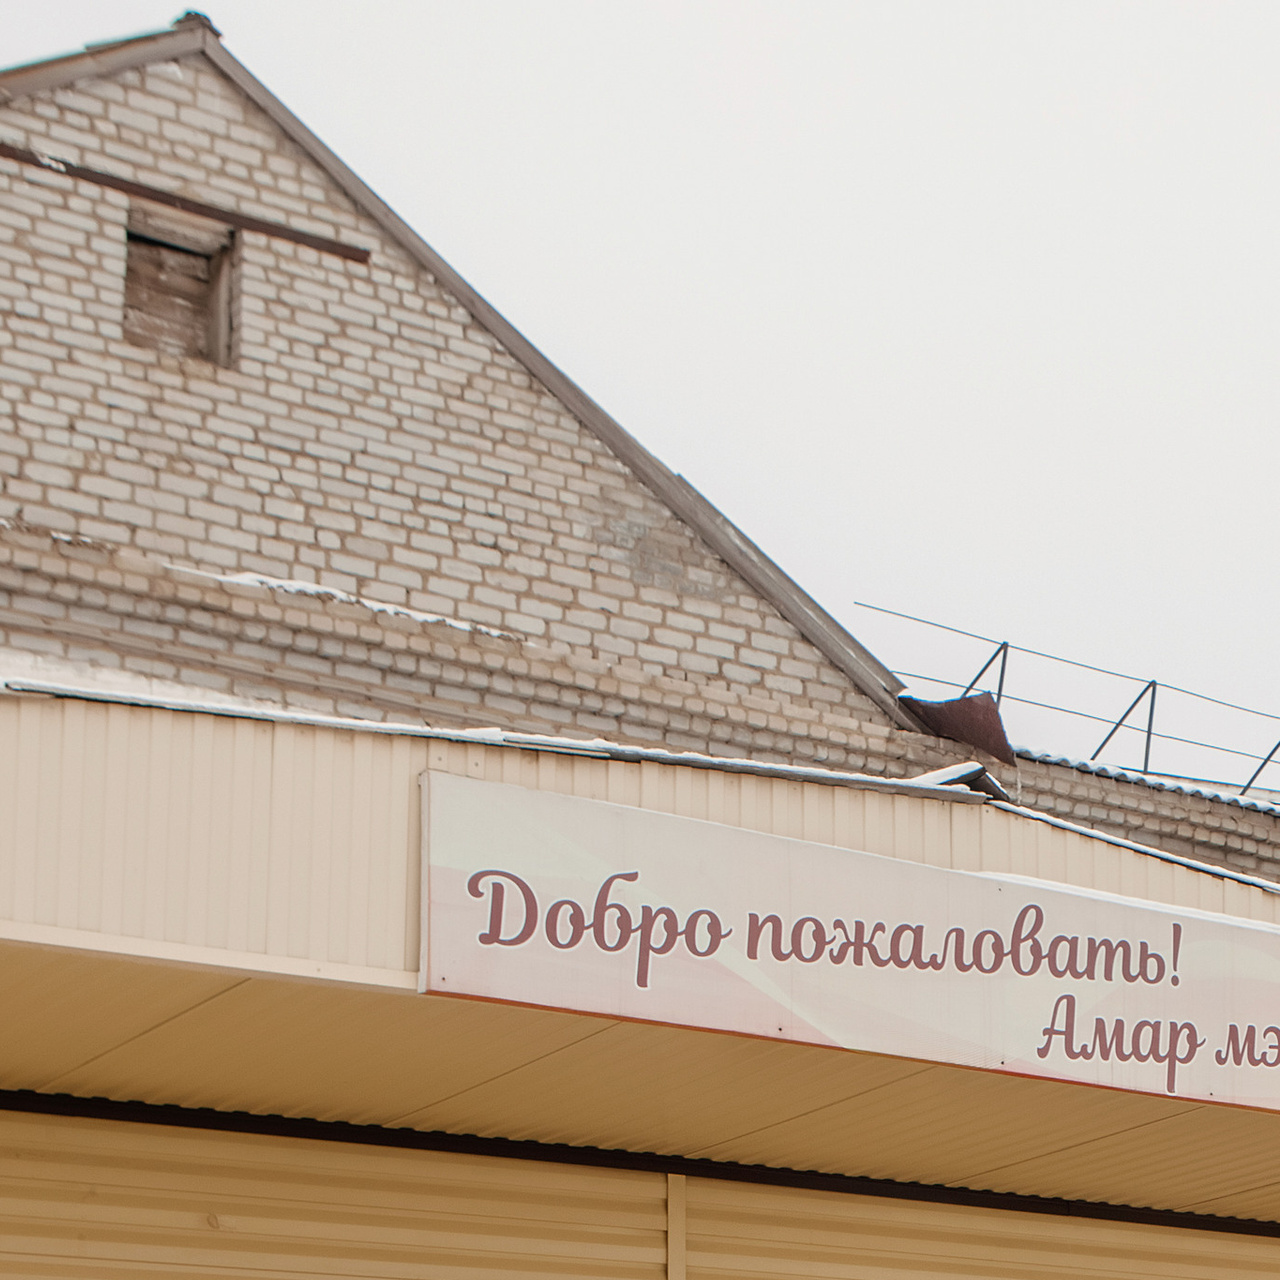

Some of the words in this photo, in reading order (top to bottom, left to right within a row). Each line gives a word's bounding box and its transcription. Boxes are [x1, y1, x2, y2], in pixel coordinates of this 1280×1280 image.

[467, 869, 732, 988] Добро
[746, 903, 1182, 986] пожаловать!
[1038, 993, 1206, 1094] Амар
